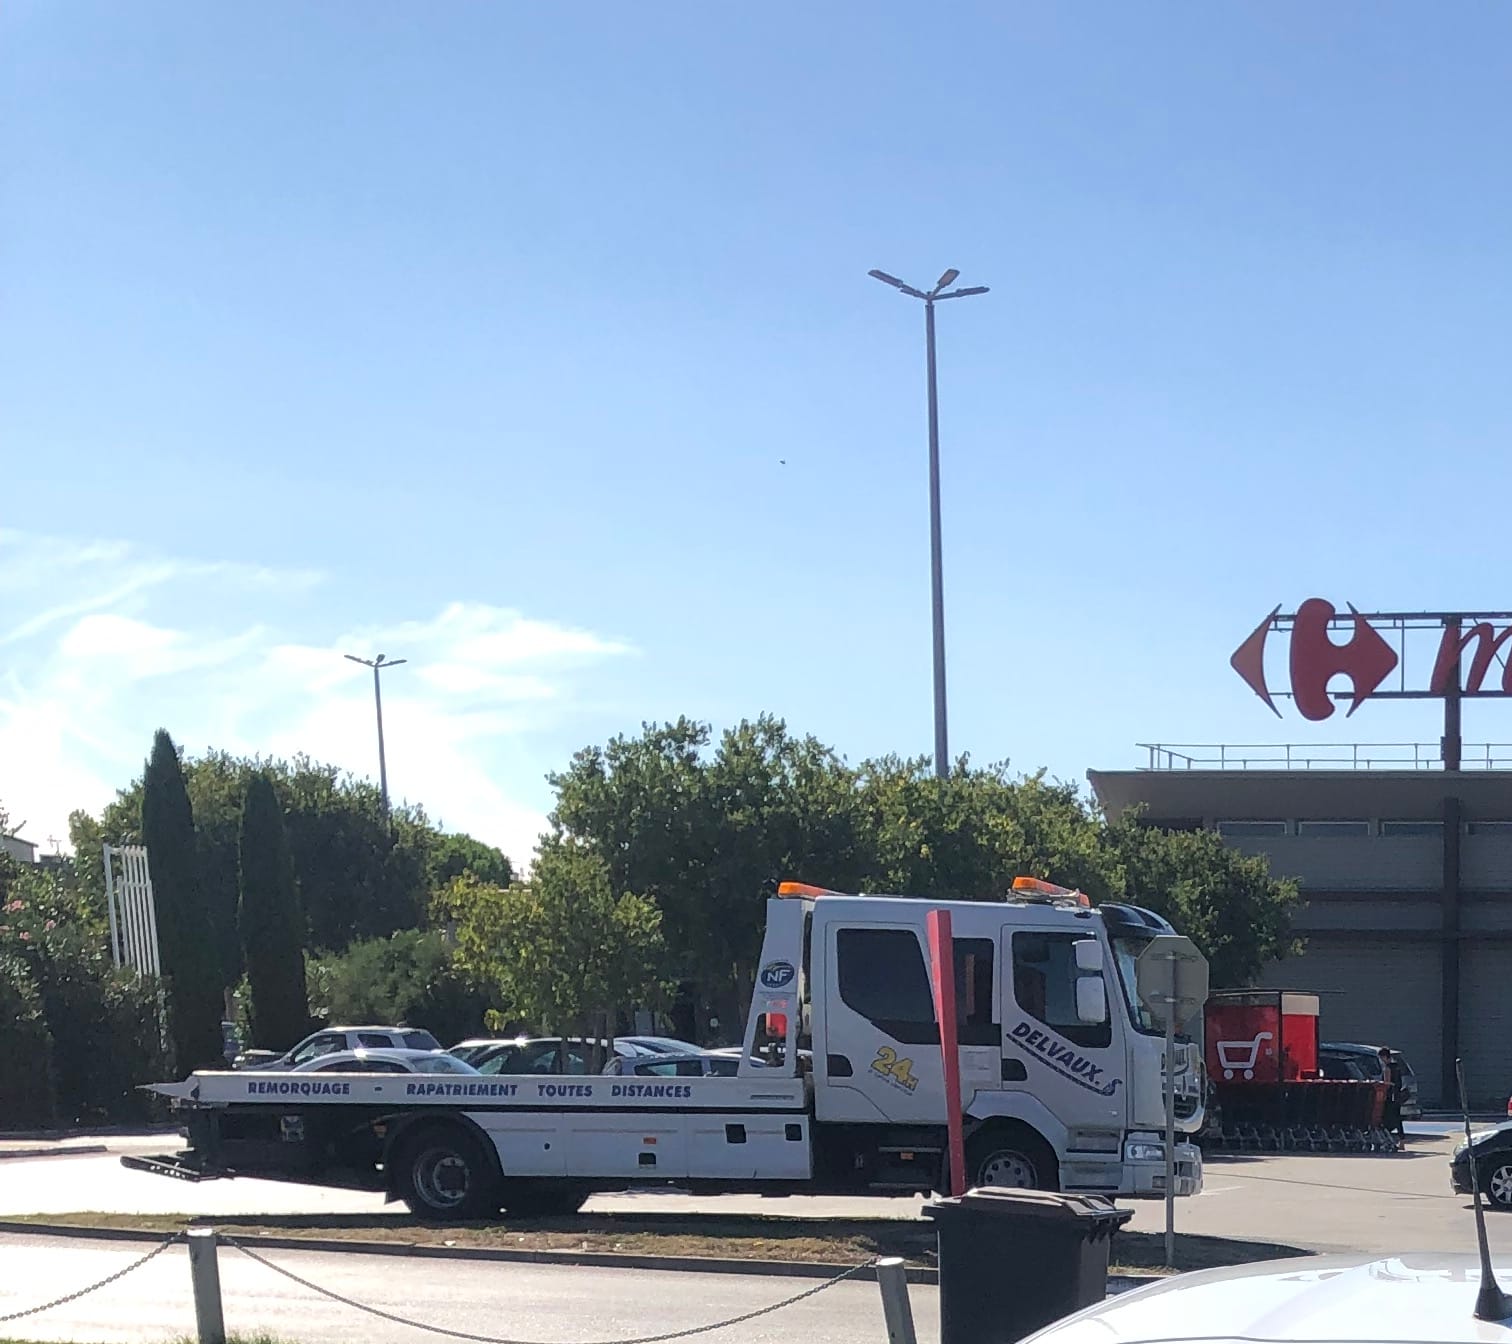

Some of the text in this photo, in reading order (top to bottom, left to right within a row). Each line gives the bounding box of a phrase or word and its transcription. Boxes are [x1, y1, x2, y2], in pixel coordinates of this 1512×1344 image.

[767, 969, 791, 982] NF
[248, 1081, 350, 1096] REMORQUAGE
[406, 1083, 518, 1097] RAPATRIEMENT
[537, 1084, 593, 1097] TOUTES
[611, 1085, 692, 1098] DISTANCES
